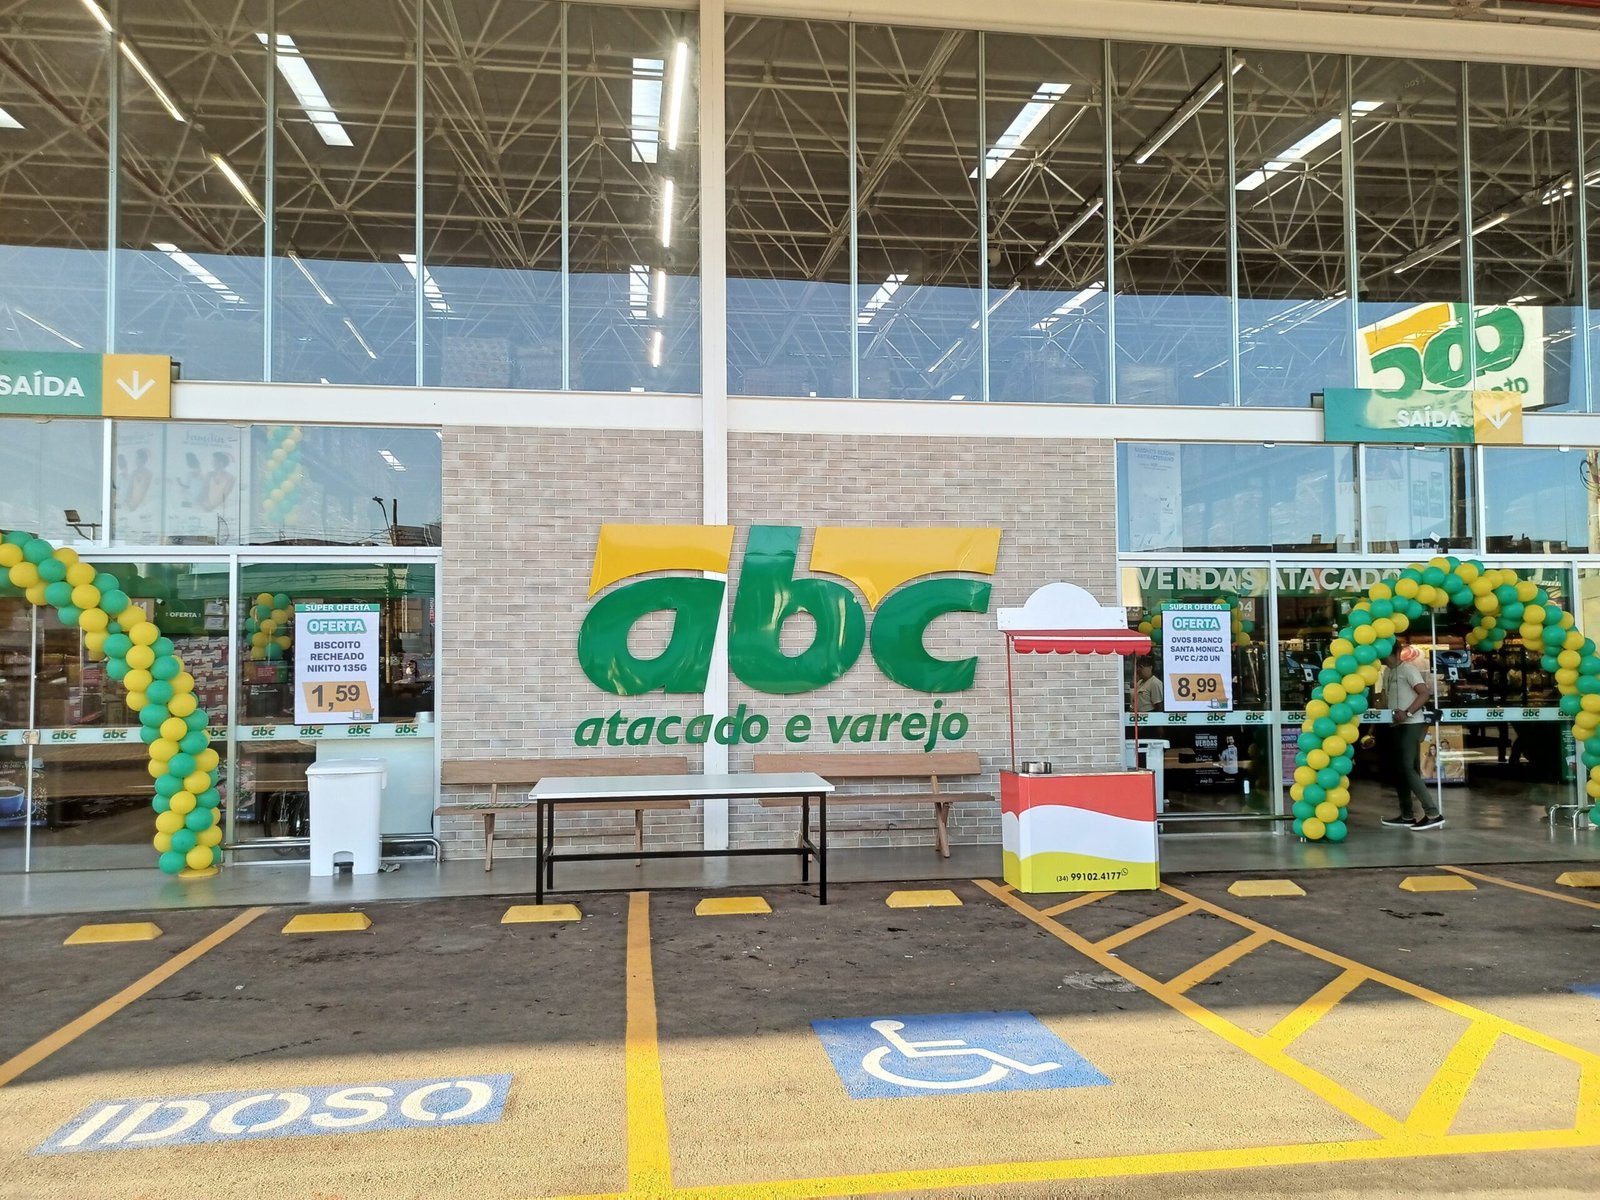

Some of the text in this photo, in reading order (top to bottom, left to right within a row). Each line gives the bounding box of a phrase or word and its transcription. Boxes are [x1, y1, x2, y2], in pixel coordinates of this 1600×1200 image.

[0, 369, 86, 398] SAÍDA
[1397, 405, 1462, 428] SAÍDA
[1136, 567, 1256, 590] VENDAS
[305, 603, 371, 611] SUPER OFERTA
[577, 525, 993, 695] abc
[308, 620, 365, 632] OFERTA
[1173, 618, 1219, 629] OFERTA
[313, 641, 361, 649] BISCOITO
[1170, 645, 1224, 653] SANTA MONICA
[310, 652, 365, 661] RECHEADO
[307, 663, 368, 673] NIKITO 135G
[1177, 677, 1217, 701] 8,99
[311, 684, 361, 712] 1,59
[1168, 712, 1187, 722] abc
[1207, 712, 1226, 721] abc
[1245, 711, 1264, 721] abc
[1287, 711, 1307, 721] abc
[1363, 710, 1381, 719] abc
[1450, 709, 1468, 718] abc
[1486, 708, 1504, 717] abc
[1522, 707, 1540, 717] abc
[251, 726, 276, 736] abc
[300, 725, 324, 735] abc
[347, 724, 372, 734] abc
[395, 724, 419, 734] abc
[573, 699, 970, 753] atacado e varejo
[52, 729, 77, 740] abc
[103, 728, 128, 739] abc
[1071, 871, 1121, 881] 99102.4177
[58, 1080, 493, 1148] IDOSO
